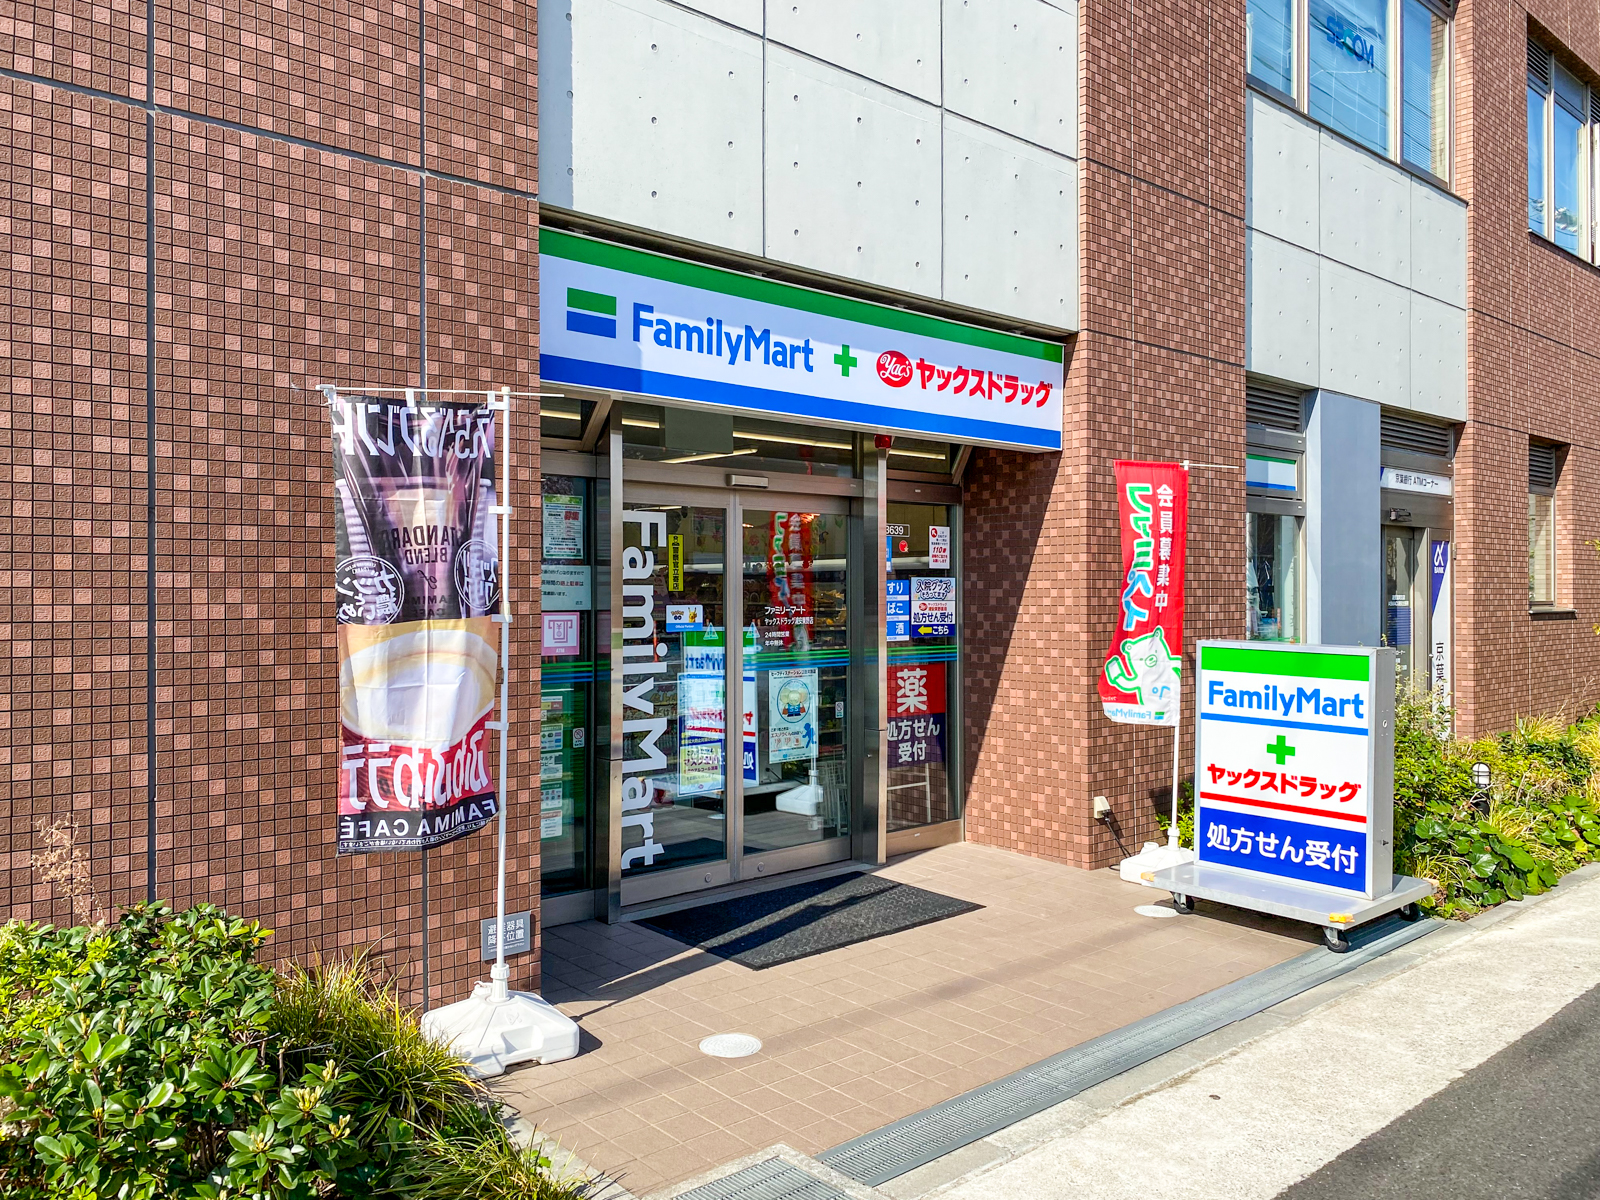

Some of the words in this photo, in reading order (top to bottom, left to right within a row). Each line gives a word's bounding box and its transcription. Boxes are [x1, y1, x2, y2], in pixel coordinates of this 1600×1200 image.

[633, 302, 814, 373] FamilyMart
[879, 354, 912, 379] Yac's
[916, 357, 1053, 408] ヤックスドラッグ
[887, 582, 903, 594] すり
[916, 579, 951, 592] 入院グッズ
[764, 606, 806, 615] ファミリーマート
[887, 602, 904, 614] ばこ
[913, 612, 953, 623] 処方せん受付
[895, 622, 904, 634] 酒
[932, 625, 949, 635] こちら
[621, 510, 668, 871] FamilyMart
[896, 668, 928, 713] 薬
[1208, 680, 1364, 719] FamilyMart
[887, 717, 940, 741] 処方せん
[898, 739, 927, 763] 受付
[1207, 763, 1362, 803] ヤックスドラッグ
[1206, 821, 1359, 875] 処方せん受付
